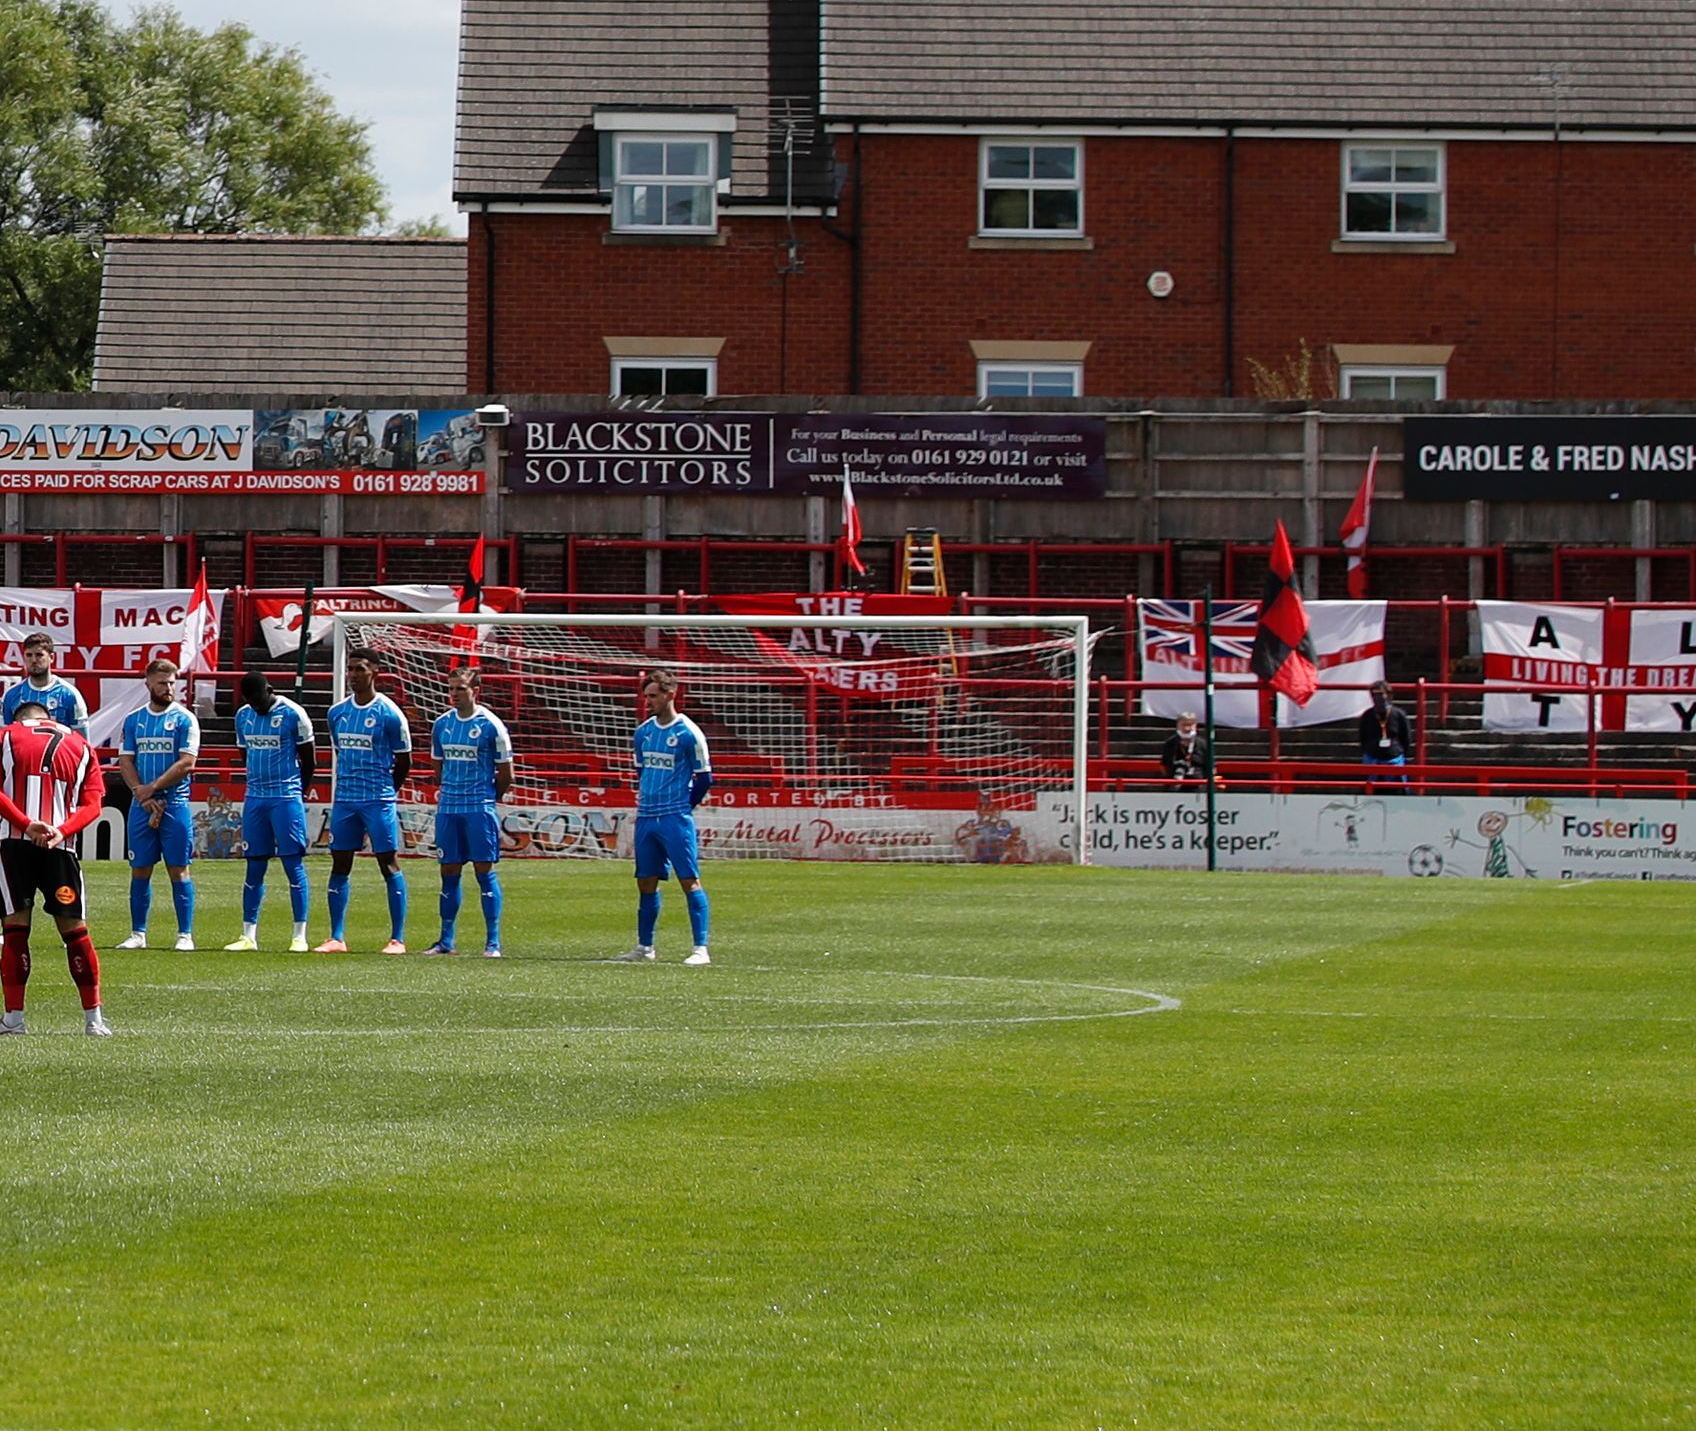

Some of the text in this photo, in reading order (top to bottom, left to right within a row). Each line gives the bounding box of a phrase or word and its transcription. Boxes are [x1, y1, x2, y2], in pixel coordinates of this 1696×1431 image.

[525, 422, 752, 452] BLACKSTONE
[791, 429, 1082, 446] For your Business and Personal legal requirements
[786, 448, 1087, 470] Call us today on 0161 929 0121 or visit
[1419, 444, 1524, 471] CAROLE
[1530, 444, 1550, 471] &
[1557, 445, 1624, 471] FRED
[36, 474, 70, 489] PAID
[73, 474, 105, 489] FOR
[108, 474, 162, 490] SCRAP
[165, 474, 208, 490] CARS
[210, 474, 231, 490] AT
[234, 474, 244, 490] J
[246, 474, 340, 490] DAVIDSON'S
[352, 475, 396, 492] 0161
[400, 475, 434, 492] 928
[436, 476, 479, 493] 9981
[525, 459, 751, 484] SOLICITORS
[809, 471, 1063, 486] wwwBlackstoneSolicitorsLtd.co.uk
[114, 605, 185, 628] MAC
[795, 597, 864, 616] THE
[788, 627, 882, 657] ALTY
[1529, 615, 1561, 649] A
[3, 642, 171, 670] ATY FC
[1512, 658, 1588, 686] LIVING
[1596, 667, 1637, 687] THE
[1531, 694, 1561, 727] T
[32, 725, 64, 773] 7
[138, 740, 172, 751] mbna
[246, 737, 279, 749] mbna
[339, 736, 371, 749] mbna
[444, 747, 477, 760] mbna
[1113, 804, 1240, 830] is my foser
[723, 819, 801, 846] Metal
[810, 818, 934, 848] Processors
[1172, 834, 1184, 850] a
[1563, 815, 1678, 845] Fostering
[1562, 846, 1592, 858] Think
[1596, 848, 1616, 860] you
[1653, 848, 1681, 859] Think
